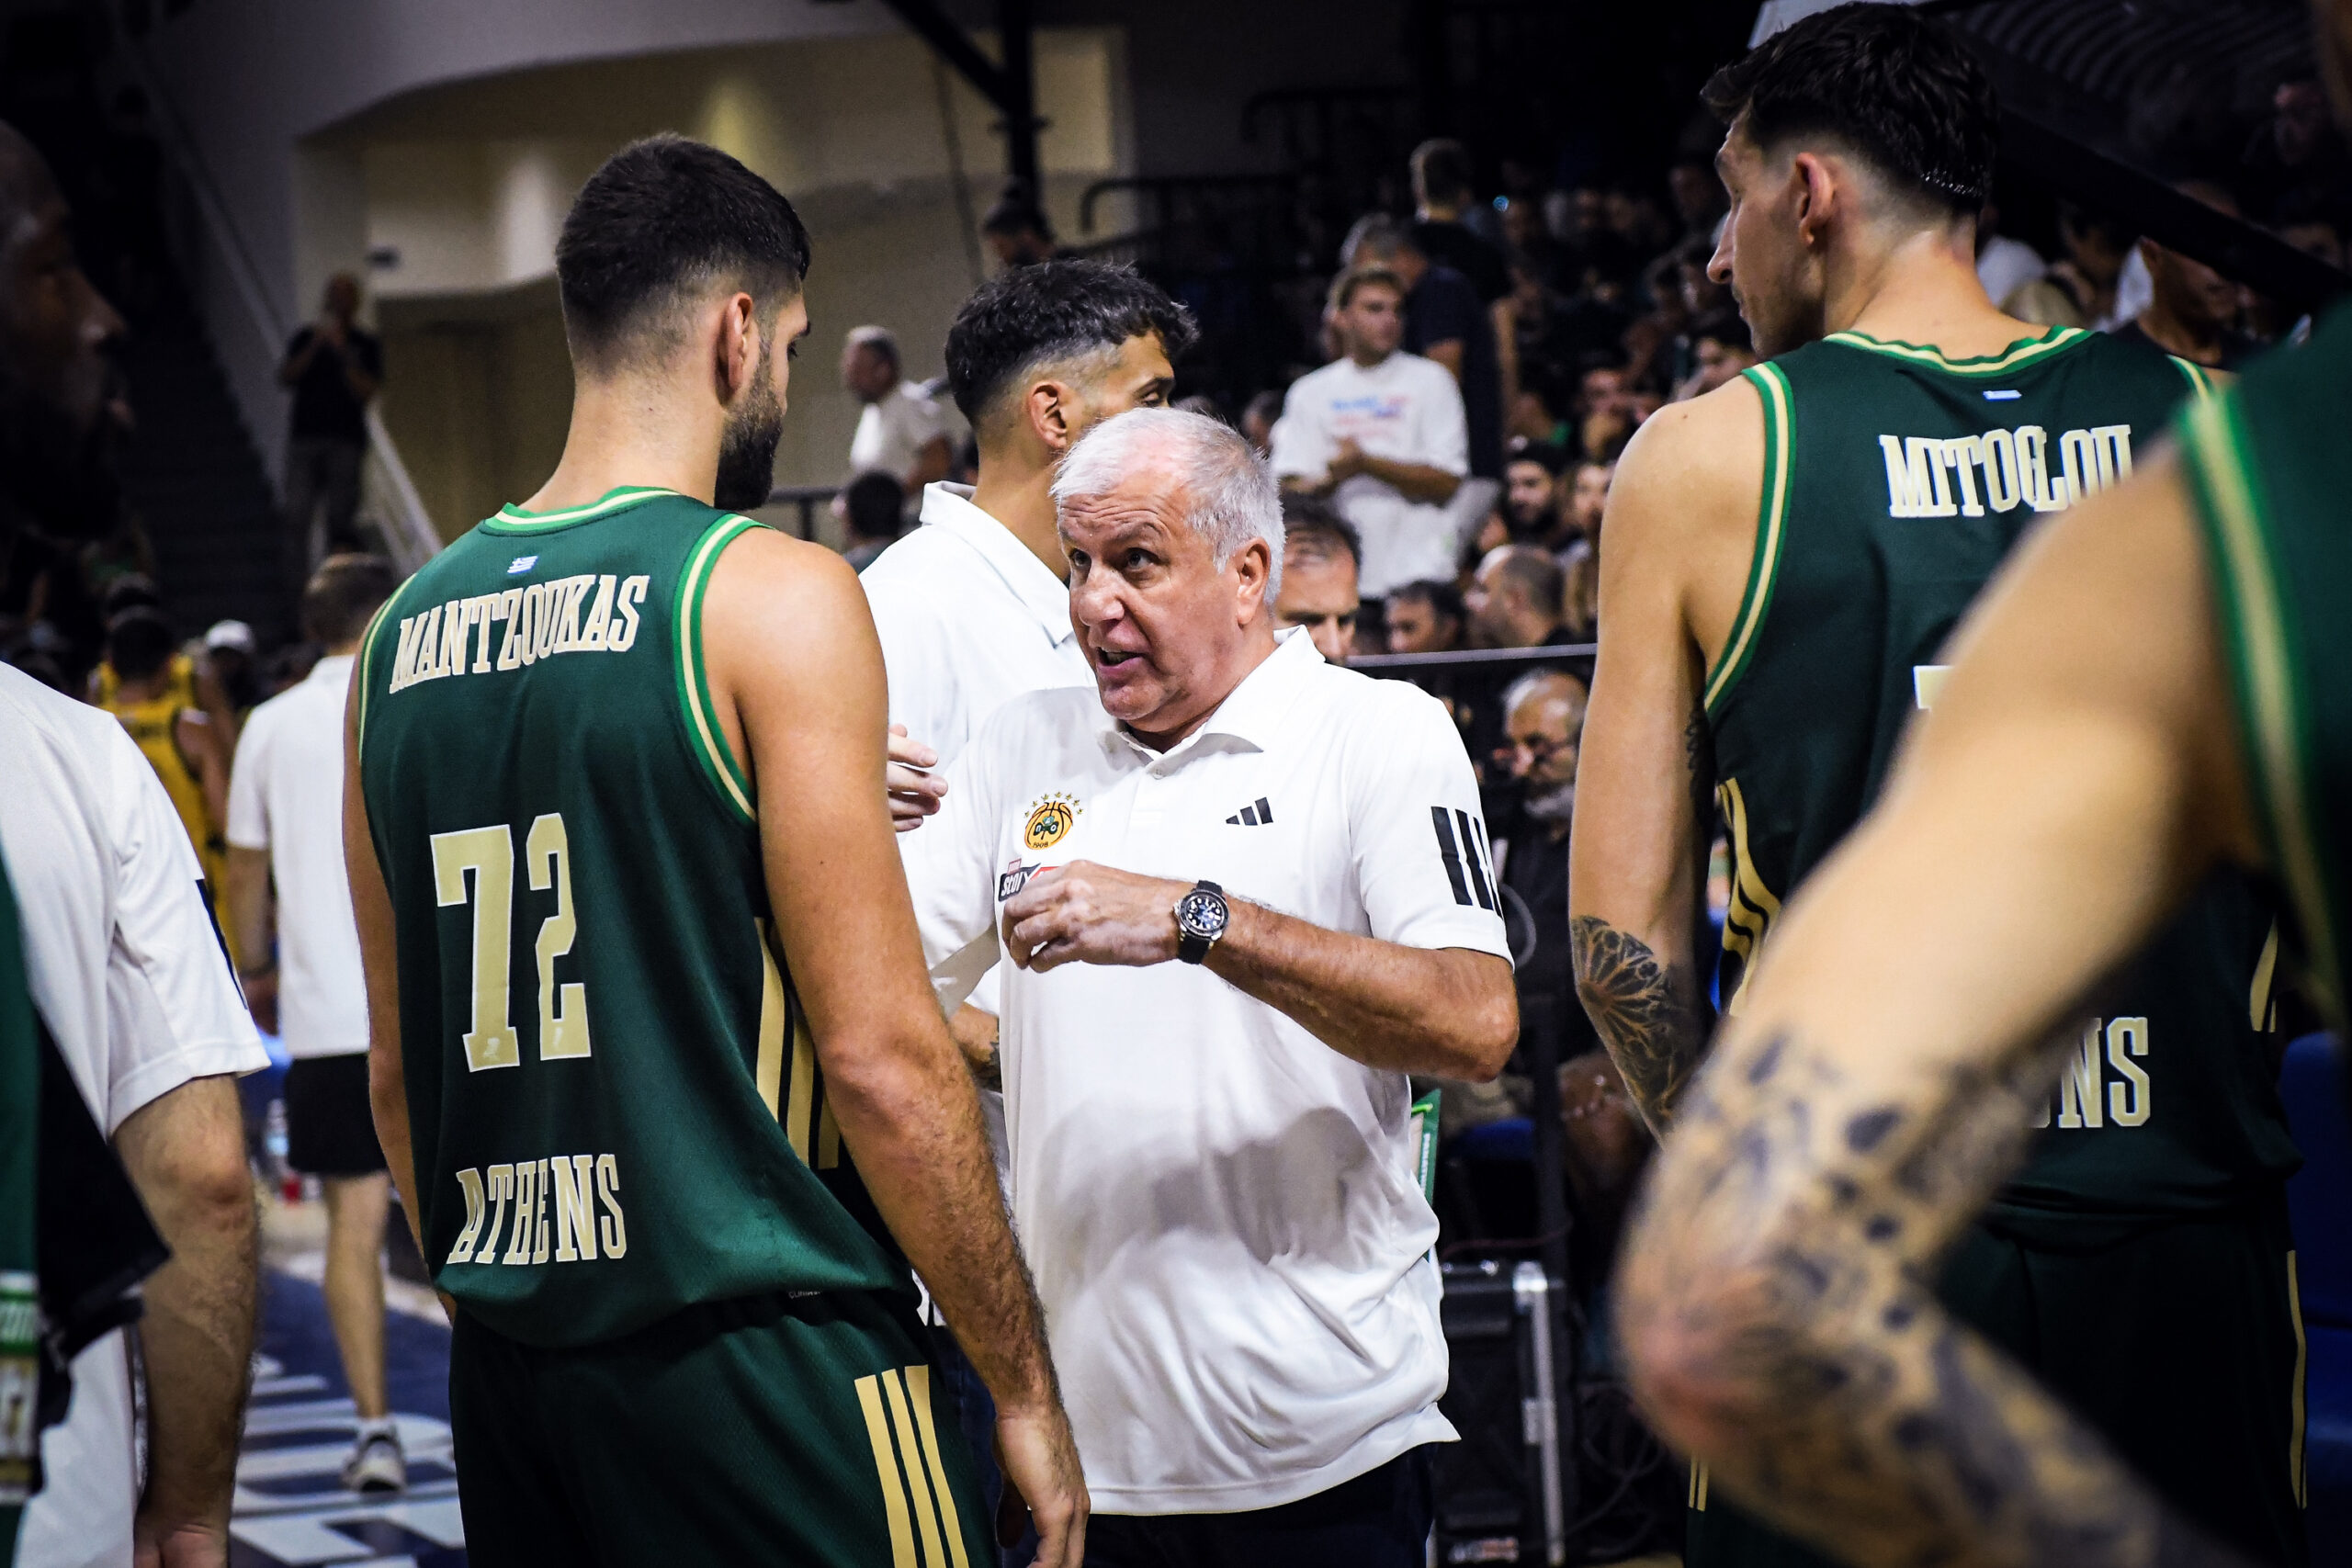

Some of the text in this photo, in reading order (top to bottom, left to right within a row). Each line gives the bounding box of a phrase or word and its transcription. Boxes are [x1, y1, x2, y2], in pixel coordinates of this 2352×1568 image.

[1878, 424, 2134, 518] MITOGLOU
[389, 574, 650, 695] MANTZOUKAS
[429, 812, 592, 1073] 72
[446, 1154, 627, 1265] ATHENS
